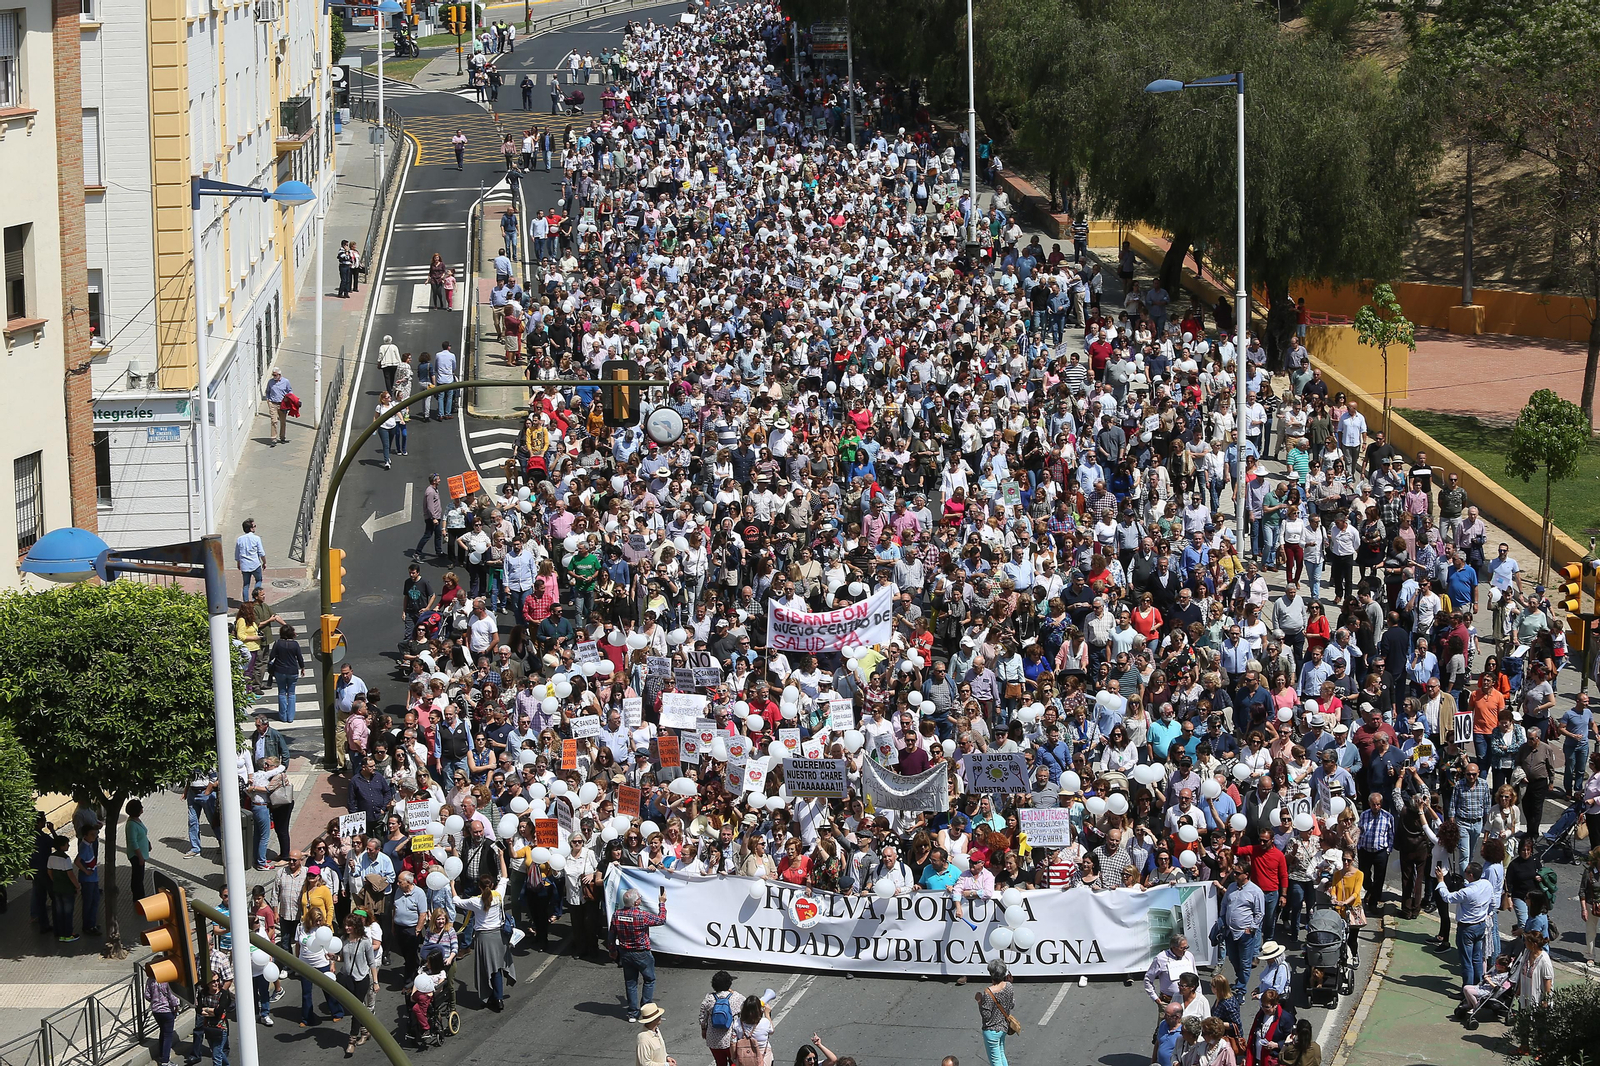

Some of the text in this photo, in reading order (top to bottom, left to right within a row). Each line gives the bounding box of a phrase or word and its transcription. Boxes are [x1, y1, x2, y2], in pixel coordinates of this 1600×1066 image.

[773, 609, 891, 637] NUEVO CENTRO DE
[772, 634, 826, 652] SALUD
[687, 651, 711, 668] NO
[1455, 715, 1470, 739] NO
[792, 760, 836, 769] QUEREMOS
[786, 770, 843, 780] NUESTRO CHARE
[408, 802, 429, 811] RECORTES
[414, 810, 430, 819] SANIDAD
[409, 819, 430, 827] MATAN
[763, 884, 885, 925] HLVA,
[894, 895, 959, 923] POR
[704, 921, 846, 959] SANIDAD
[852, 929, 989, 965] PÚBLICA
